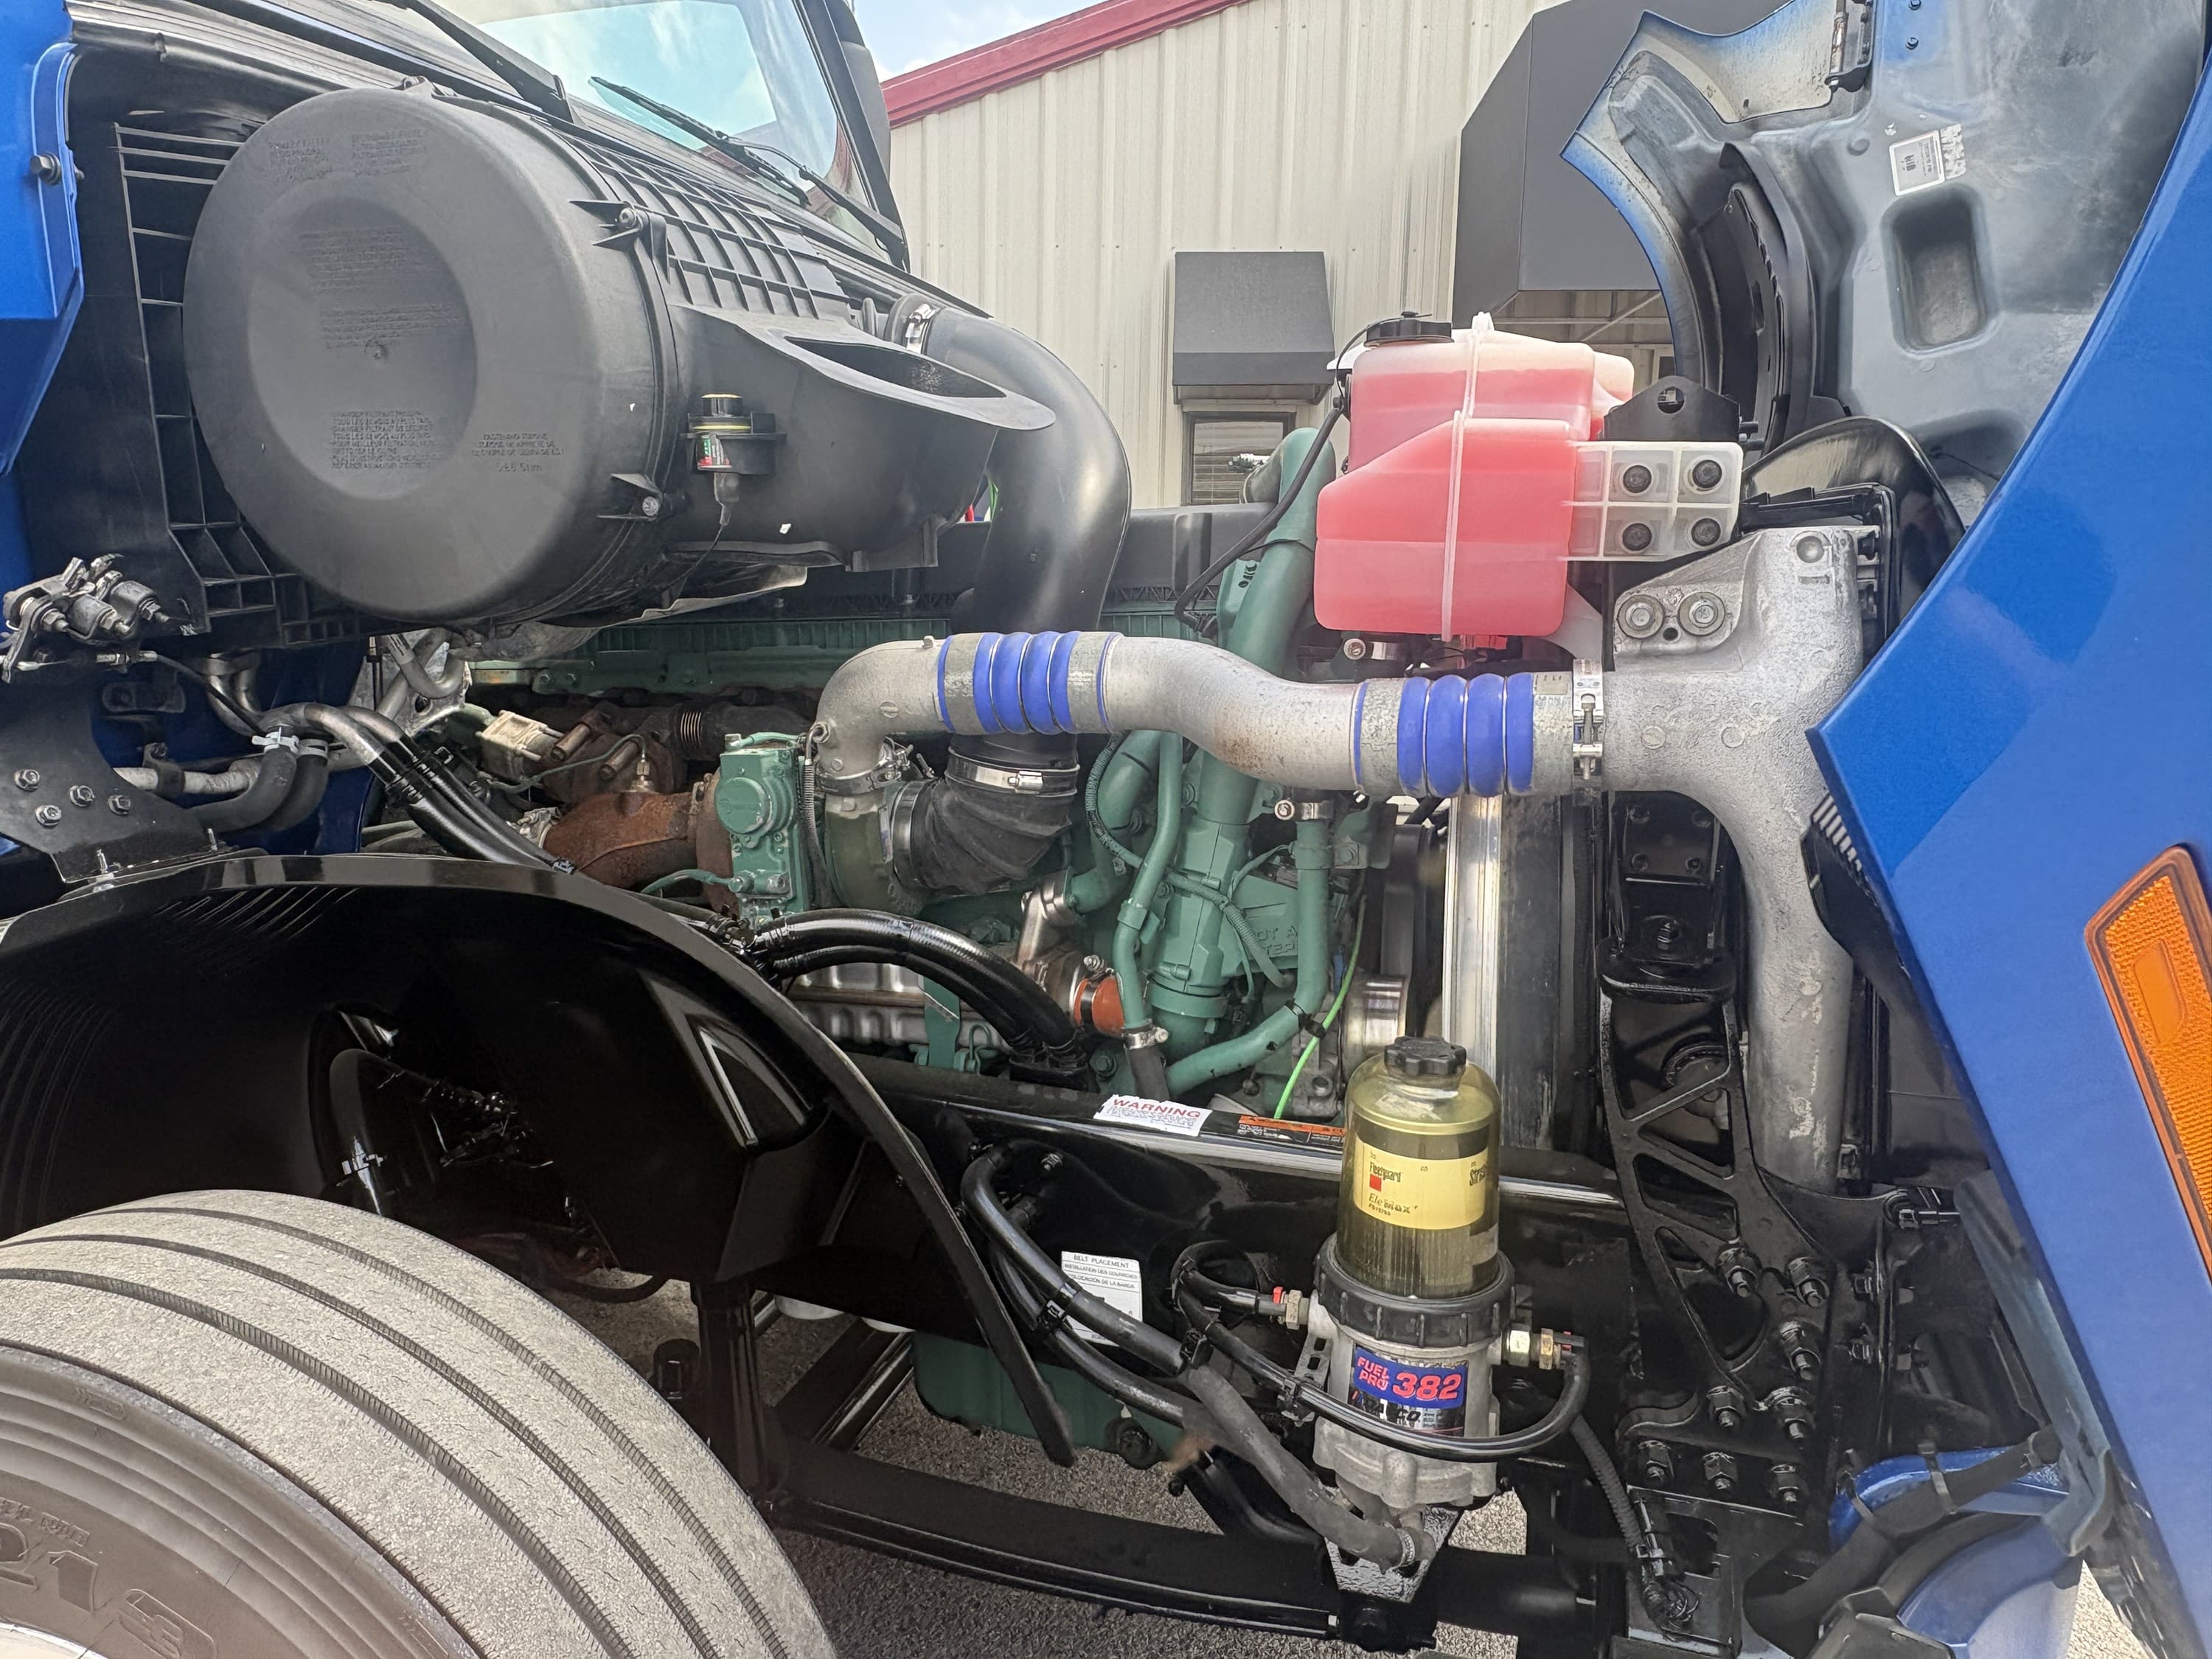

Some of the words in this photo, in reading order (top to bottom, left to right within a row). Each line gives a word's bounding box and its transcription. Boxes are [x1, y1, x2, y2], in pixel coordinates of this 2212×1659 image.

[1113, 1099, 1200, 1119] WARNING
[1074, 1254, 1089, 1262] BELT
[1091, 1258, 1130, 1268] PLACEMENT
[1357, 1357, 1389, 1379] FUEL
[1392, 1371, 1463, 1401] 382
[1359, 1369, 1389, 1391] PRO
